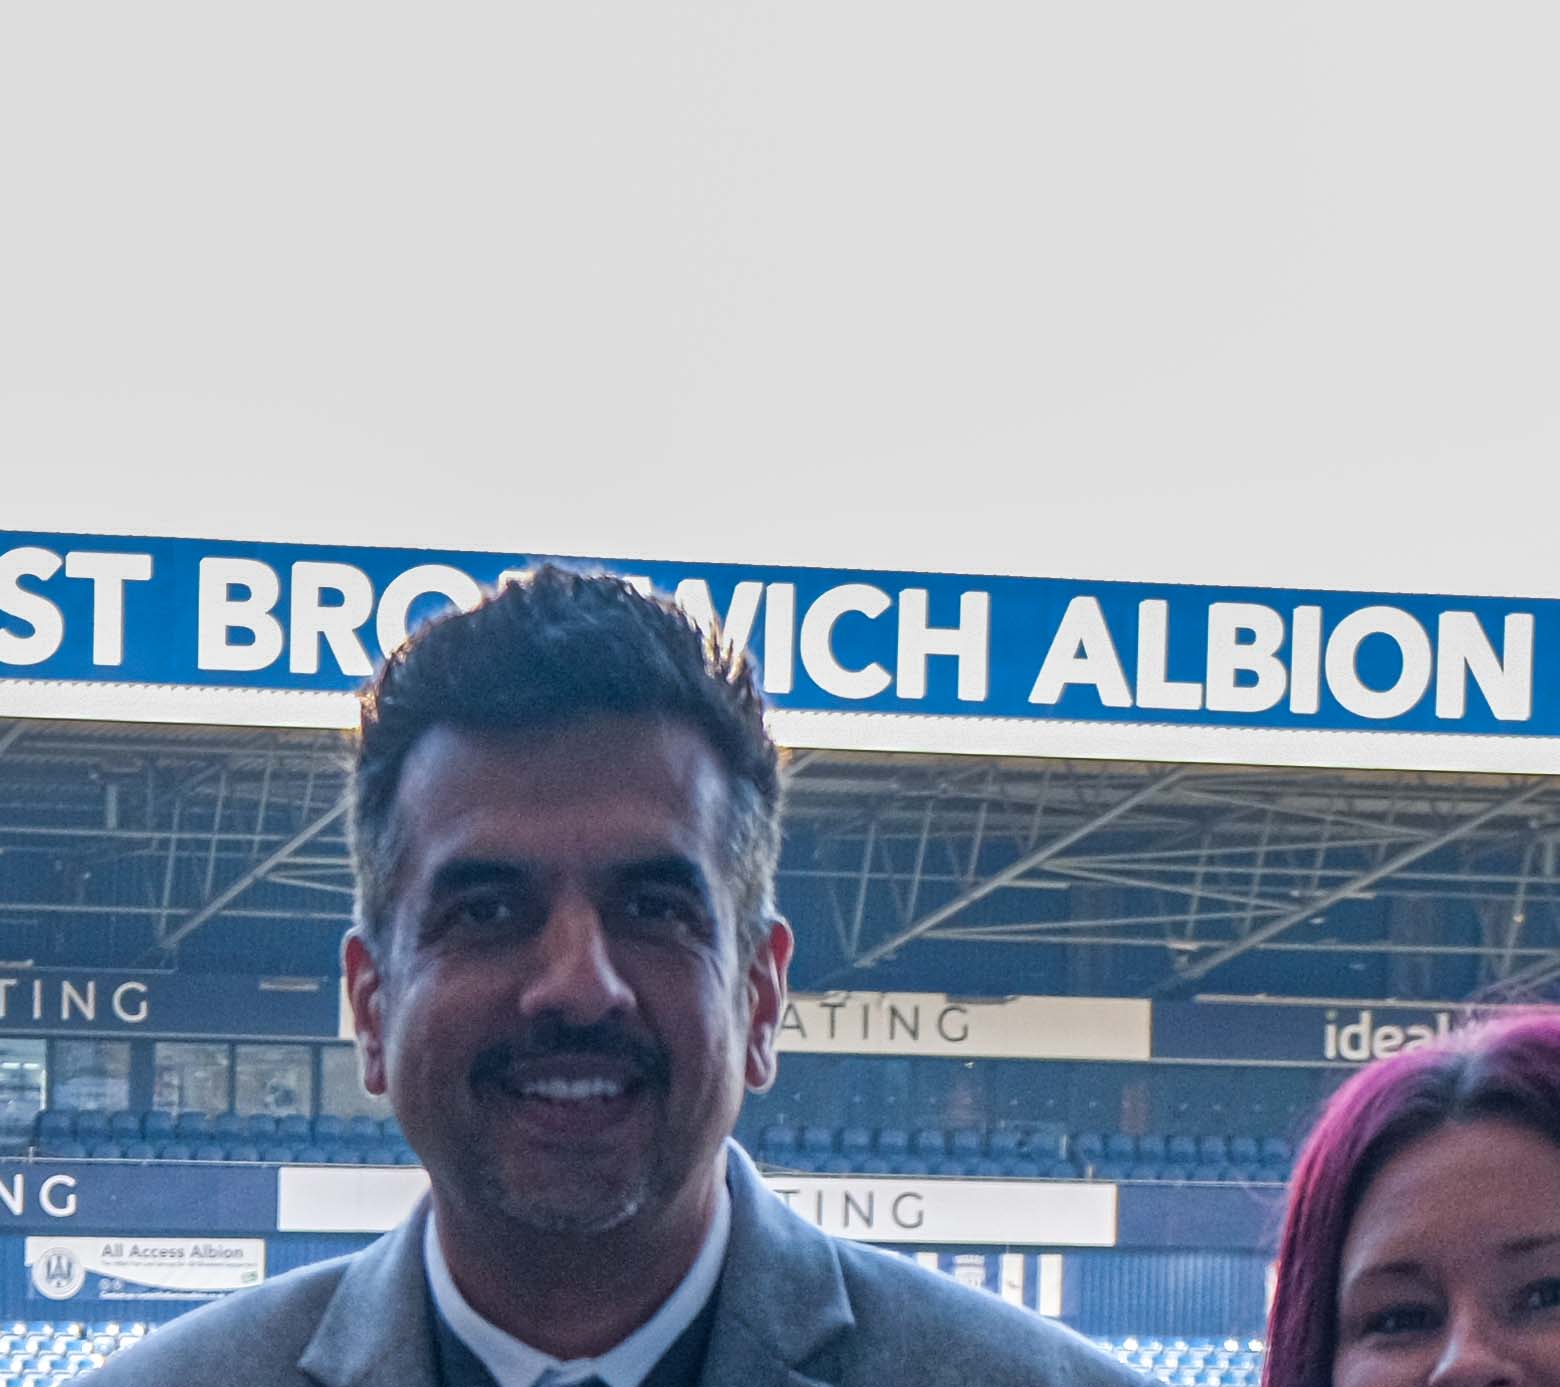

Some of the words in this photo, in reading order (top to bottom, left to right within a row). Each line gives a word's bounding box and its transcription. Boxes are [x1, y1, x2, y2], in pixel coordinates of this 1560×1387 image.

[197, 555, 990, 705] BROWICH
[1027, 595, 1536, 723] ALBION
[779, 1000, 969, 1043] ATING
[101, 1244, 124, 1258] All
[129, 1244, 185, 1258] Access
[189, 1245, 245, 1259] Albion
